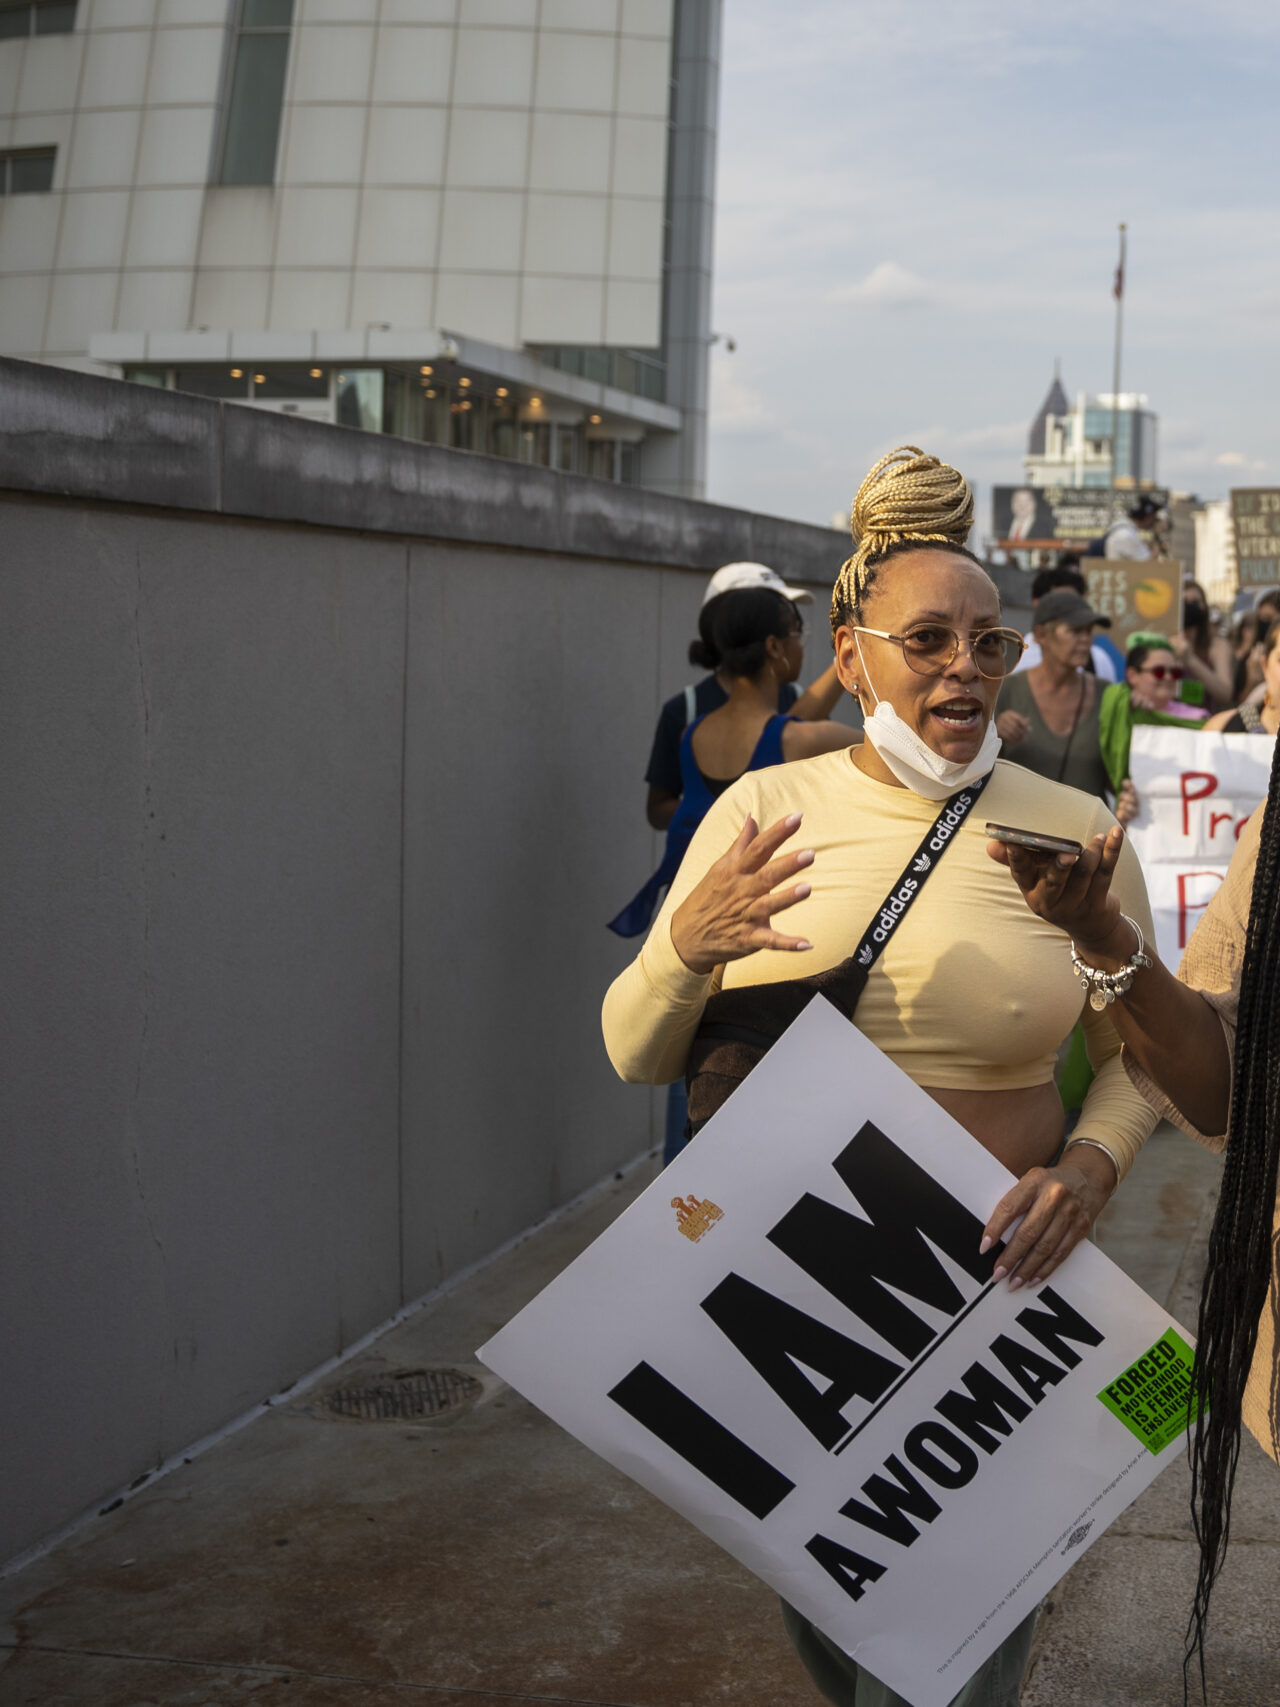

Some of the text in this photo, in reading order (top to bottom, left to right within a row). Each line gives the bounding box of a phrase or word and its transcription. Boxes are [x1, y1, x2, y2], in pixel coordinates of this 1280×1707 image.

[929, 793, 972, 852] adidas
[872, 877, 918, 943] adidas
[606, 1119, 1006, 1521] I AM
[1105, 1340, 1177, 1406] FORCED
[1120, 1358, 1186, 1417] MOTHERHOOD
[804, 1285, 1106, 1602] A WOMAN
[1130, 1409, 1150, 1428] IS
